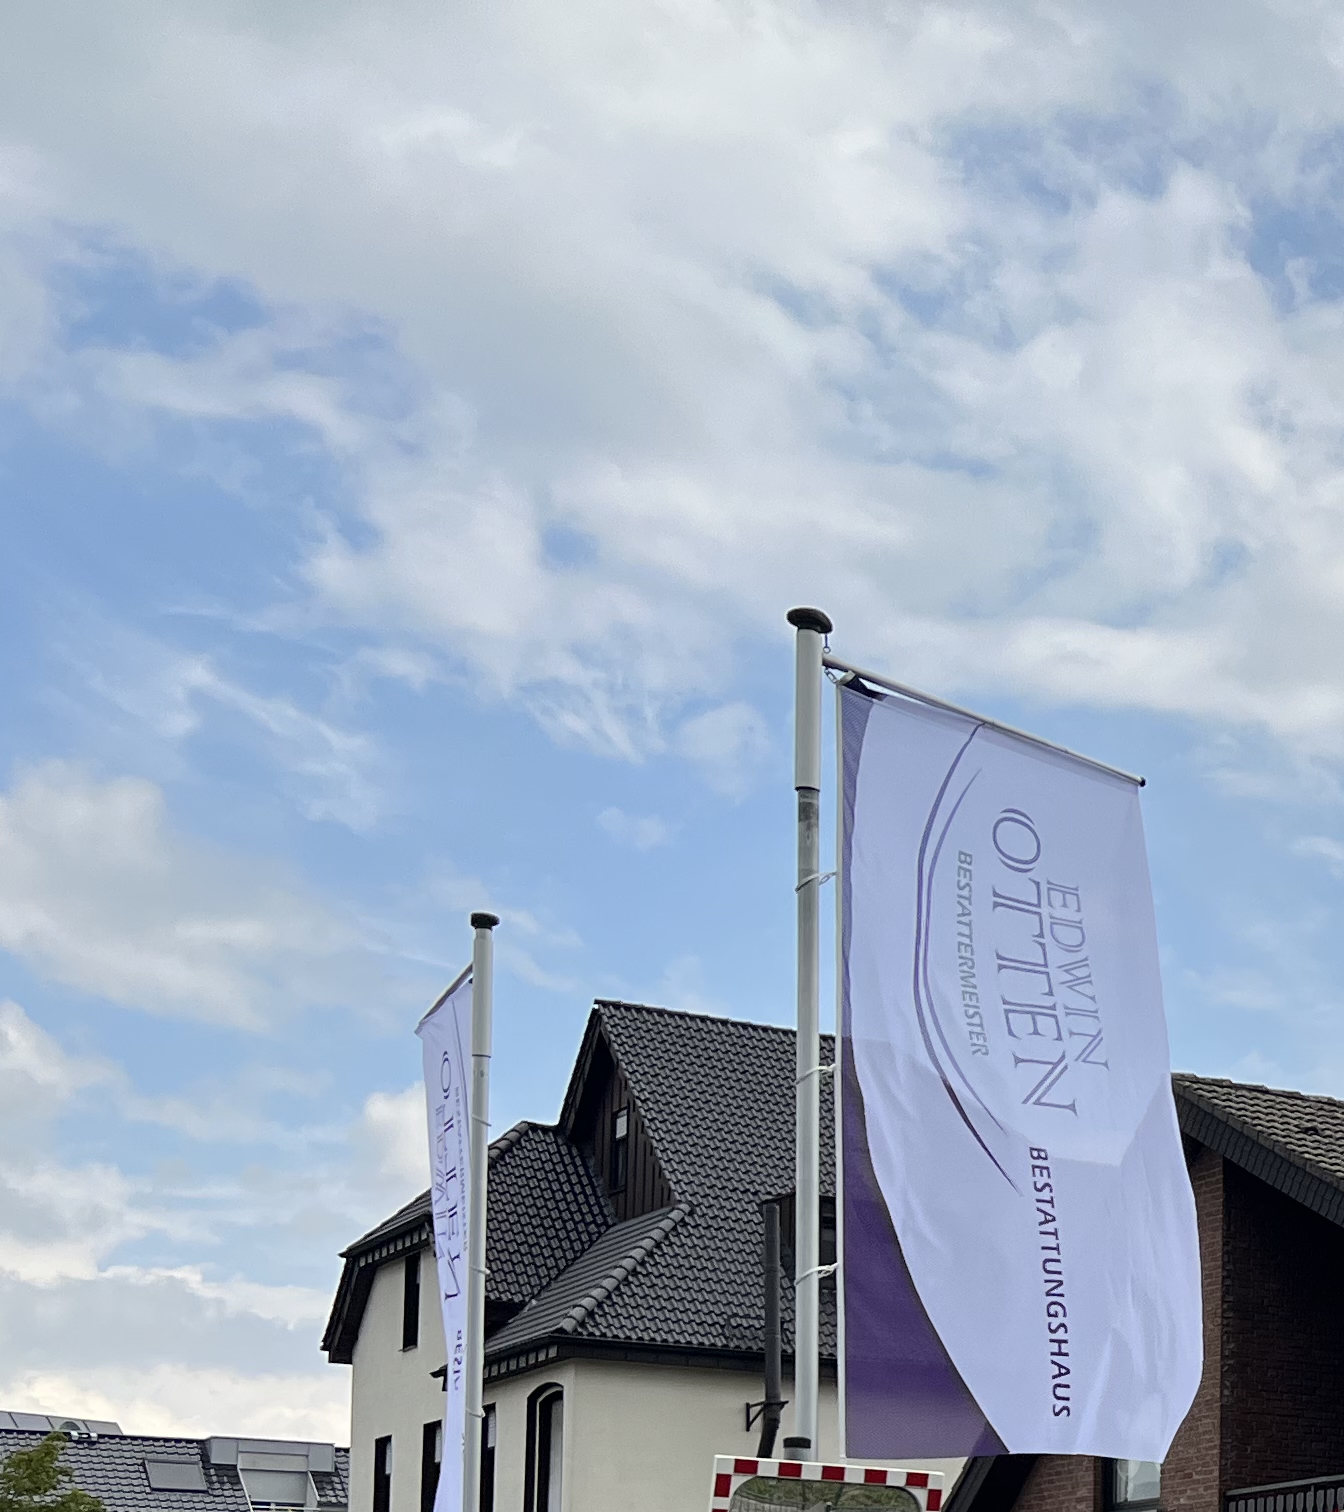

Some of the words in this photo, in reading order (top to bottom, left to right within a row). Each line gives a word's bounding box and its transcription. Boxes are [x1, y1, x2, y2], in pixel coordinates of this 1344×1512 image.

[957, 850, 989, 1057] BESTATTERMEISTER
[992, 807, 1078, 1117] OTTEN
[1046, 877, 1109, 1070] EDWIN
[1028, 1146, 1071, 1419] BESTATTUNGSHAUS
